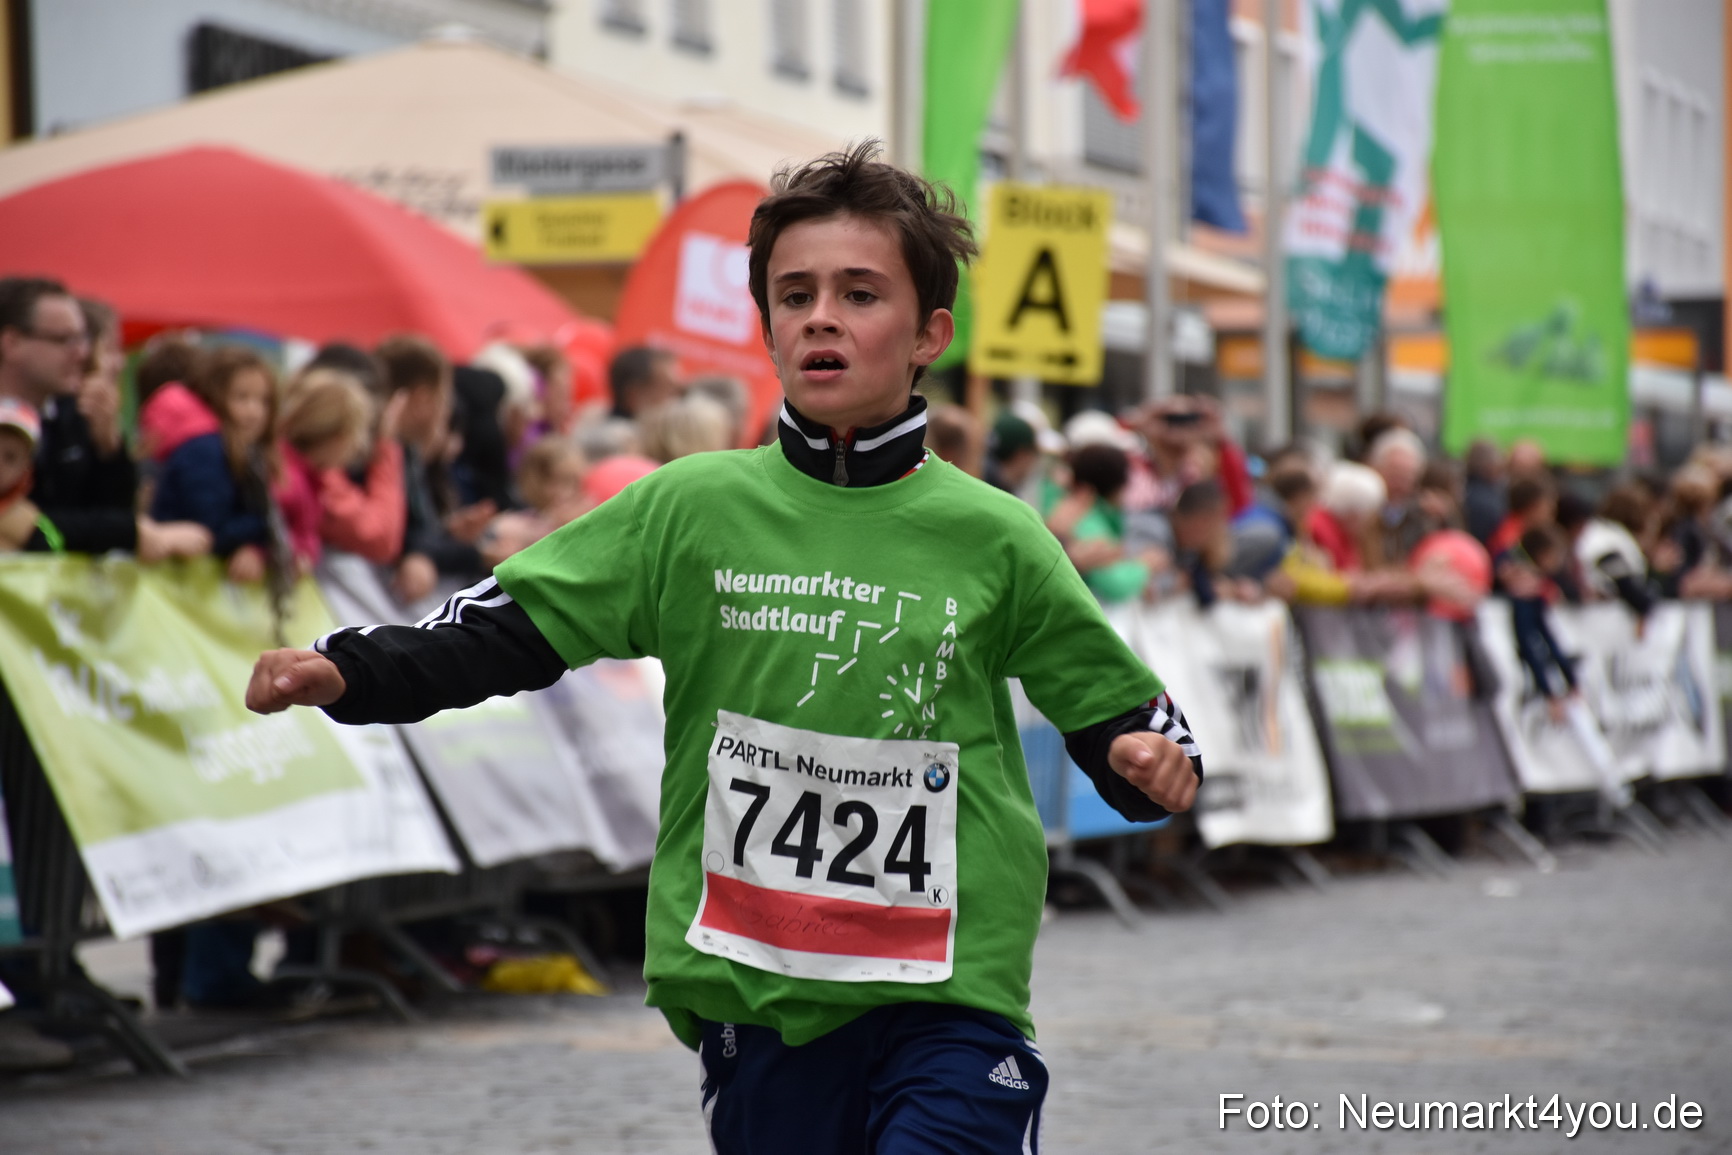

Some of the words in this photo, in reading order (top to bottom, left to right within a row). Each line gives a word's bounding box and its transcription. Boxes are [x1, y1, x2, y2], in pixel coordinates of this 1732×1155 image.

[1004, 195, 1097, 232] Block
[1008, 246, 1071, 333] A
[714, 568, 886, 605] Neumarkter
[719, 604, 846, 642] Stadtlauf
[716, 736, 789, 772] PARTL
[796, 755, 913, 788] Neumarkt
[729, 777, 931, 893] 7424
[720, 1022, 737, 1058] Gabr
[988, 1072, 1030, 1091] adidas
